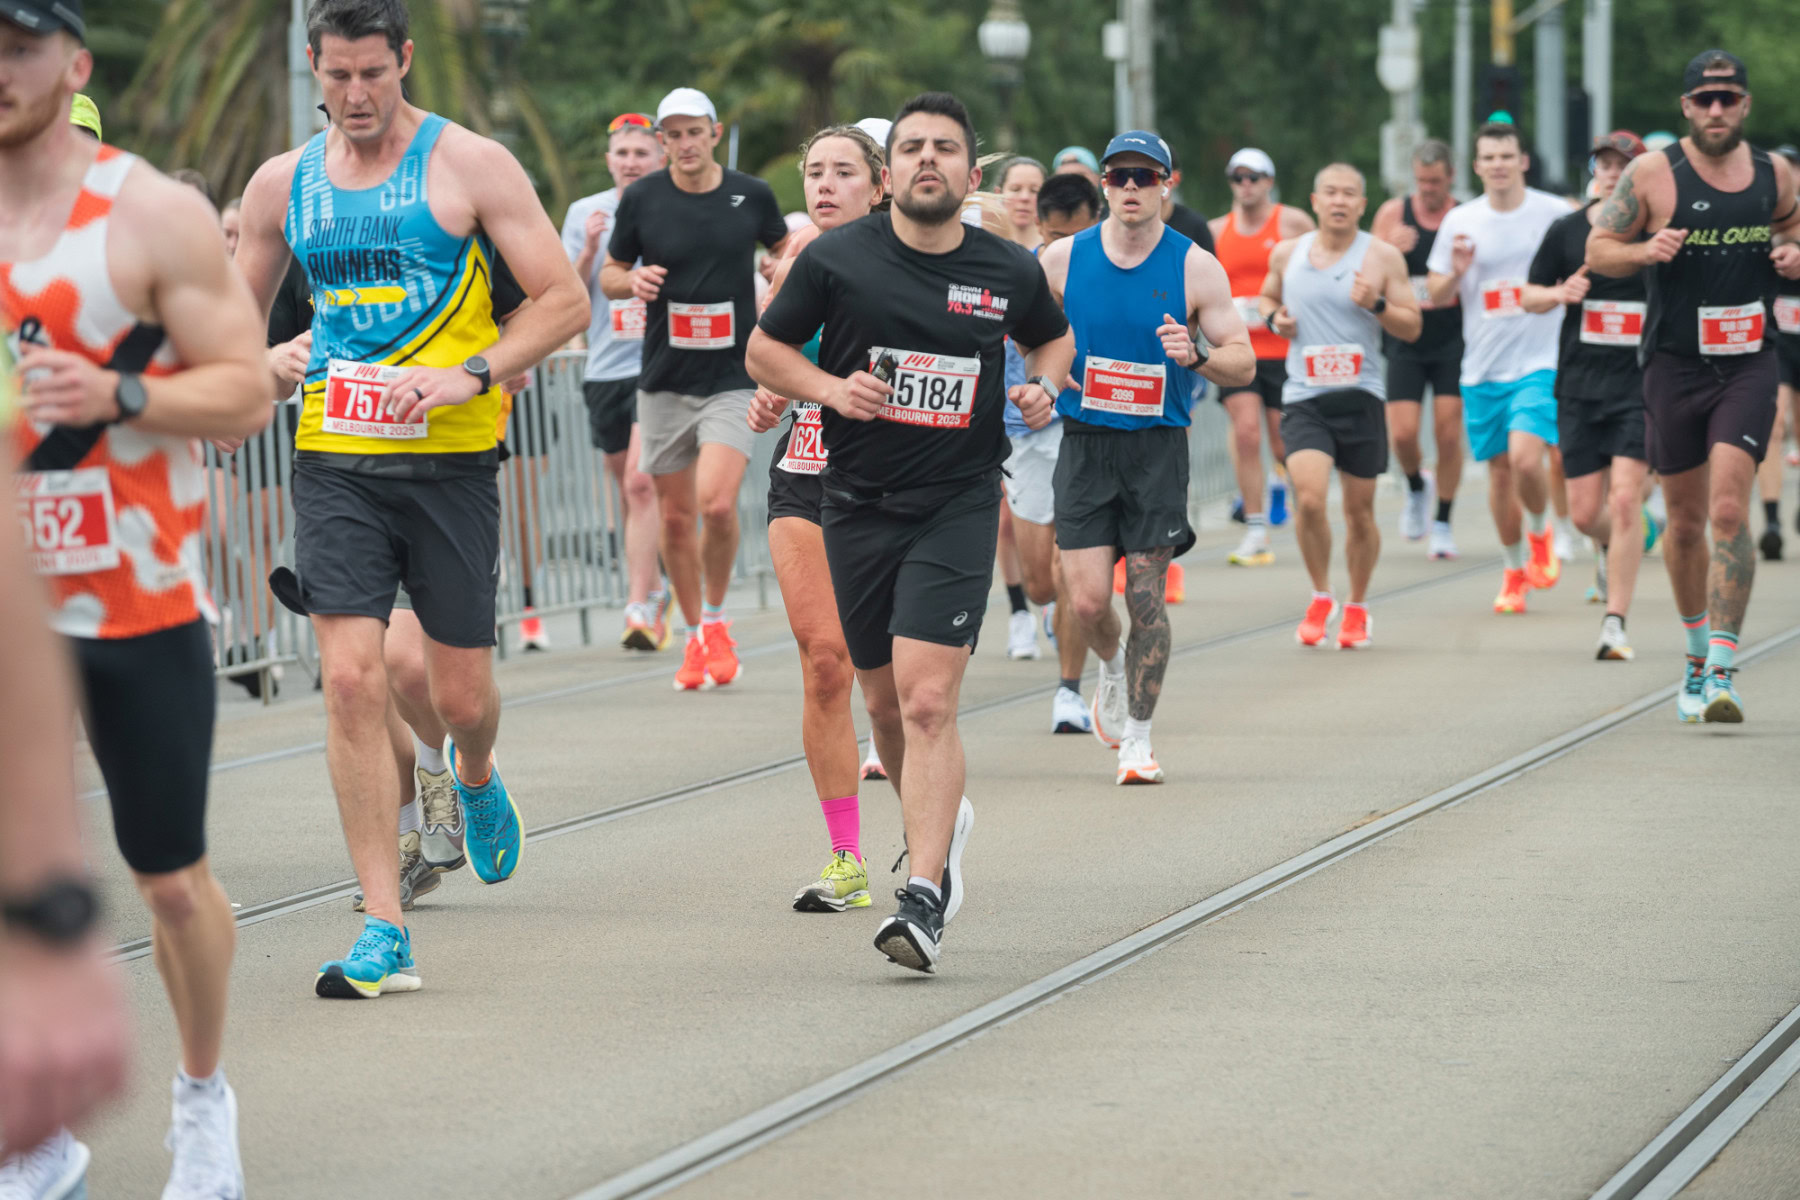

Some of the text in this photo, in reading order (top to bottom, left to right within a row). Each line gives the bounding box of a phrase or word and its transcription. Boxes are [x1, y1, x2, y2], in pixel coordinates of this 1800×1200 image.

[306, 216, 404, 249] SOUTH BANK
[1685, 225, 1770, 245] ALL OURS
[307, 250, 401, 286] RUNNERS
[947, 301, 973, 315] 70.3
[1111, 388, 1135, 402] 2099
[1090, 399, 1133, 411] MELBOURNE
[876, 406, 961, 425] MELBOURNE 2025
[333, 421, 416, 436] MELBOURNE 2025
